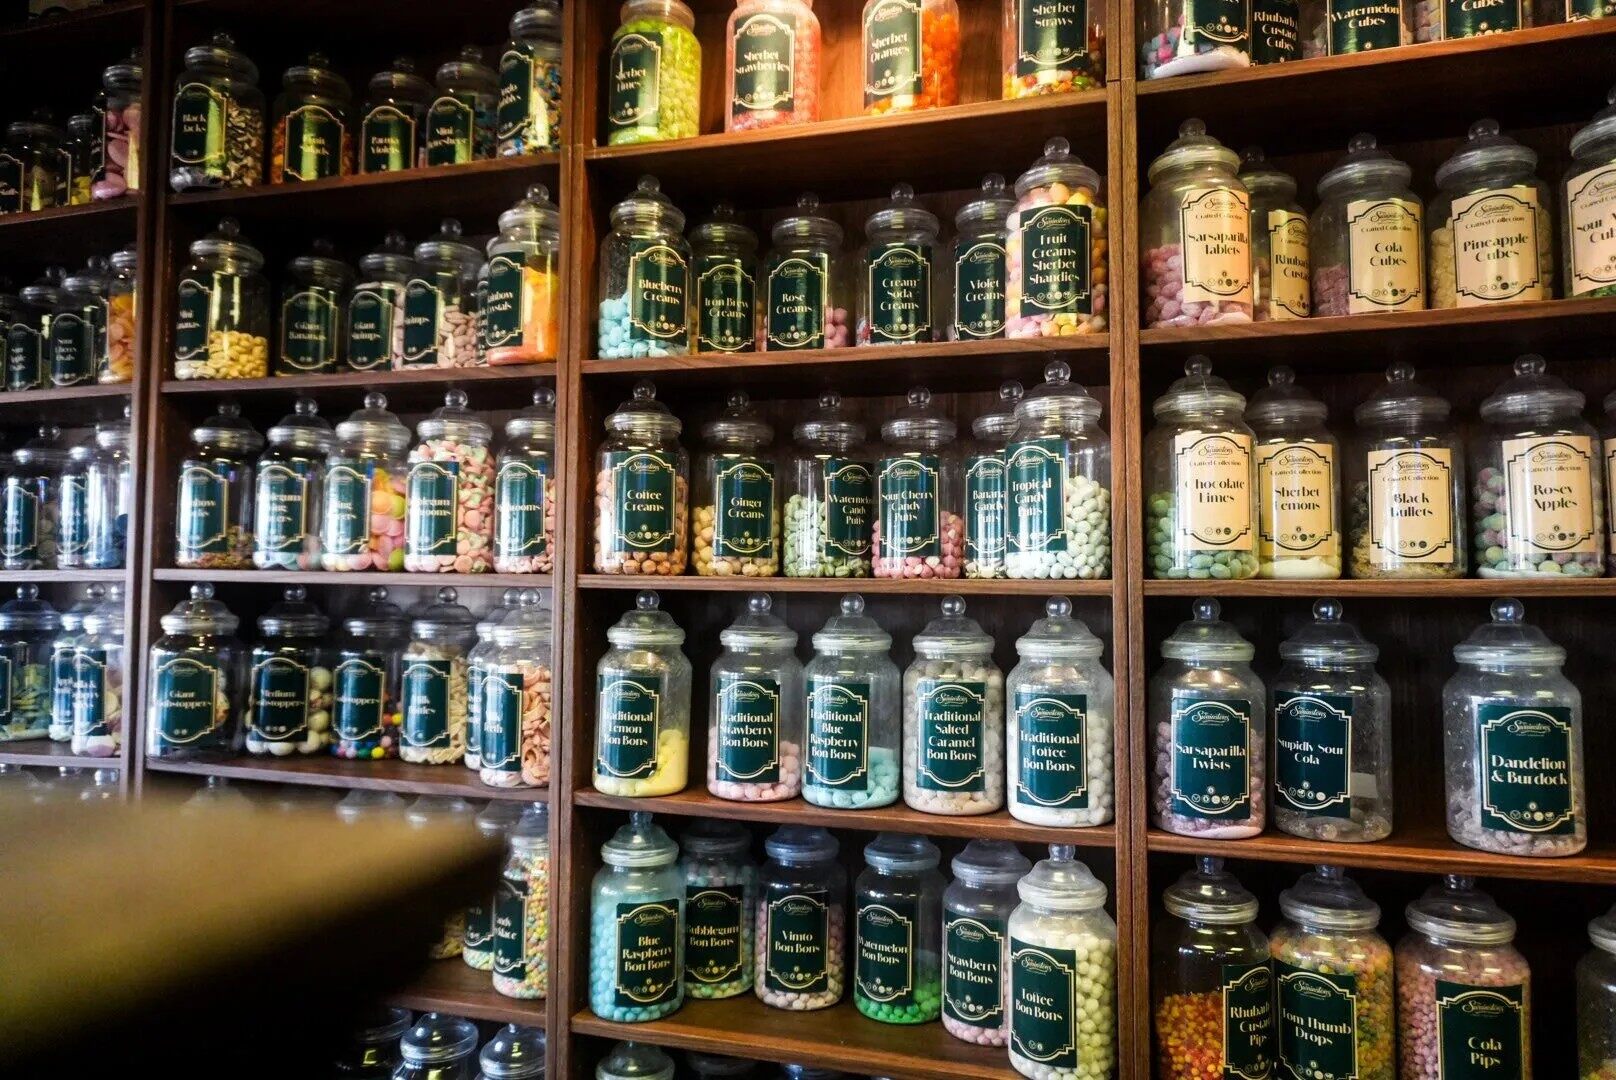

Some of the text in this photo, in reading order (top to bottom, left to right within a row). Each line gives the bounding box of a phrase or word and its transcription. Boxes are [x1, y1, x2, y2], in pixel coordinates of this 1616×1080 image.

[1032, 2, 1076, 16] Sherbet
[1331, 3, 1399, 22] Watermelon
[1035, 17, 1073, 27] Straws
[1254, 11, 1297, 29] Rhubarb
[1349, 17, 1386, 29] Cubes
[1262, 23, 1297, 41] Custard
[871, 33, 908, 50] Sherbet
[1267, 38, 1294, 51] Cubes
[744, 50, 779, 62] Sherbet
[870, 46, 909, 63] Oranges
[736, 62, 790, 74] Strawberries
[1577, 220, 1603, 232] Sour
[1040, 234, 1067, 245] Fruit
[1188, 231, 1248, 244] Sarsaparilla
[1464, 233, 1528, 251] Pineapple
[1032, 248, 1076, 258] Creams
[1205, 244, 1241, 255] Tablets
[1375, 242, 1403, 253] Cola
[1370, 256, 1407, 267] Cubes
[1475, 249, 1519, 262] Cubes
[1032, 260, 1076, 270] Sherbet
[1030, 273, 1080, 284] Shandies
[1284, 268, 1309, 279] Custa
[638, 279, 682, 294] Blueberry
[882, 278, 917, 288] Cream
[970, 279, 1000, 290] Violet
[643, 292, 680, 305] Creams
[782, 293, 805, 303] Rose
[887, 289, 912, 299] Soda
[966, 291, 1005, 302] Creams
[705, 297, 749, 309] Iron Brew
[776, 304, 813, 314] Creams
[880, 301, 919, 311] Creams
[709, 307, 746, 318] Creams
[1013, 478, 1051, 492] Tropical
[1534, 484, 1573, 496] Rosey
[627, 489, 661, 500] Coffee
[881, 490, 934, 501] Sour Cherry
[973, 490, 1006, 500] Banana
[1199, 492, 1235, 503] Limes
[1275, 486, 1320, 497] Sherbet
[730, 497, 762, 509] Ginger
[828, 494, 872, 504] Watermel
[1014, 493, 1045, 504] Candy
[1394, 492, 1429, 504] Black
[624, 502, 664, 512] Creams
[891, 501, 920, 511] Candy
[1275, 500, 1321, 511] Lemons
[1534, 498, 1578, 512] Apples
[727, 508, 764, 519] Creams
[1390, 506, 1433, 518] Bullets
[157, 701, 212, 709] obstoppers
[721, 712, 773, 723] Traditional
[810, 709, 862, 722] Traditional
[925, 710, 981, 721] Traditional
[608, 724, 642, 734] Lemon
[719, 725, 772, 735] Strawberry
[822, 724, 843, 733] Blue
[935, 724, 968, 734] Salted
[622, 735, 648, 746] Bons
[722, 737, 768, 747] Bon Bons
[810, 735, 858, 748] Raspberry
[929, 737, 976, 747] Caramel
[1020, 731, 1080, 744] Traditional
[1032, 746, 1066, 757] Toffee
[1176, 743, 1246, 758] Sarsaparilla
[1277, 738, 1344, 755] Stupidly Sour
[812, 747, 856, 760] Bon Bons
[927, 749, 976, 761] Bon Bons
[1295, 752, 1320, 765] Cola
[1023, 759, 1075, 771] Bon Bons
[1193, 757, 1231, 770] Twists
[1491, 754, 1566, 770] Dandelion
[1491, 770, 1567, 785] & Burdock
[638, 936, 660, 946] Blue
[782, 930, 813, 941] Vimto
[690, 937, 734, 947] Bon Bons
[775, 941, 820, 953] Bon Bons
[857, 935, 907, 954] Watermelon
[623, 947, 672, 960] Raspberry
[862, 949, 900, 964] Bon Bons
[624, 960, 671, 971] Bon Bons
[948, 954, 997, 972] Strawberry
[950, 966, 993, 985] Bon Bons
[1022, 988, 1053, 1007] Toffee
[1015, 999, 1063, 1021] Bon Bons
[1230, 1001, 1269, 1018] Rhubarb
[1240, 1015, 1271, 1033] Custar
[1282, 1008, 1351, 1035] Tom Thumb
[1250, 1034, 1267, 1047] Pips
[1295, 1026, 1333, 1047] Drops
[1468, 1036, 1502, 1051] Cola
[1470, 1052, 1500, 1069] Pips
